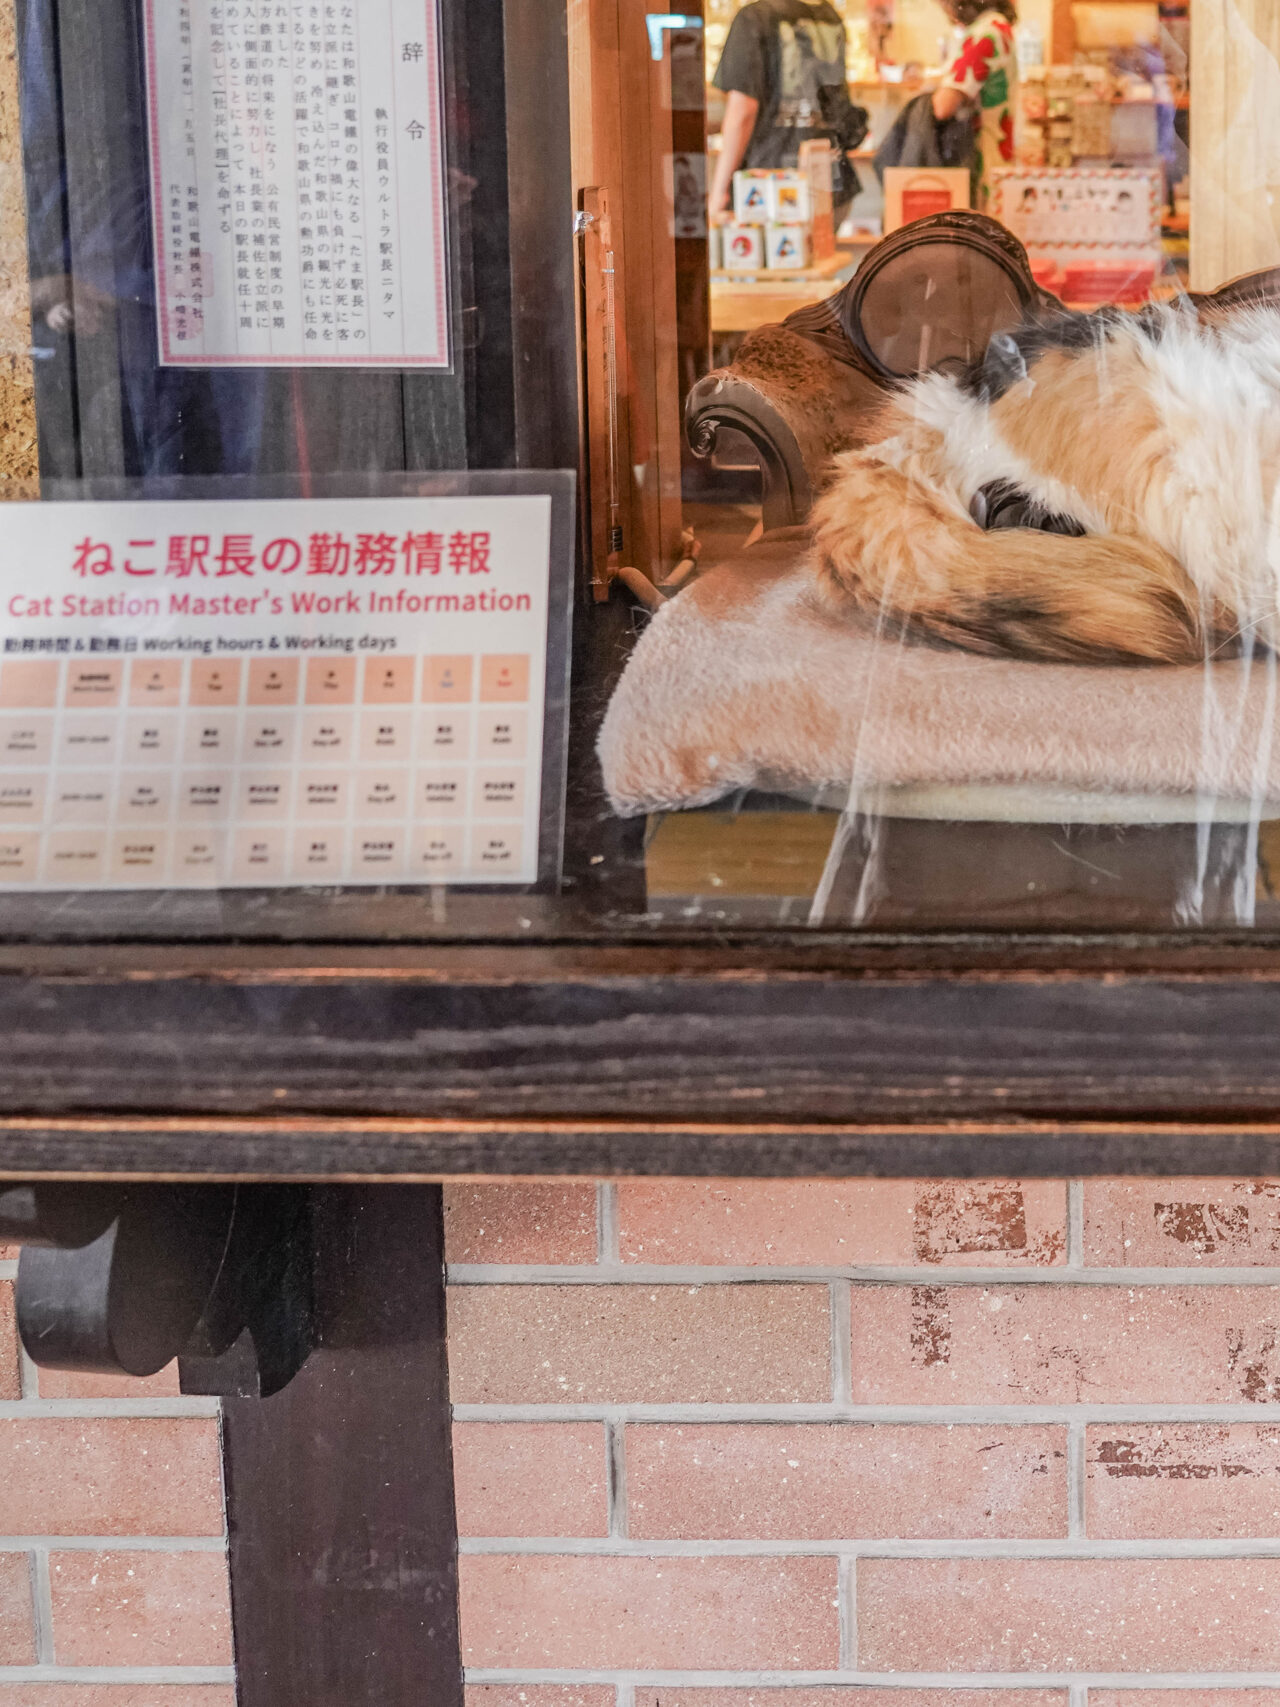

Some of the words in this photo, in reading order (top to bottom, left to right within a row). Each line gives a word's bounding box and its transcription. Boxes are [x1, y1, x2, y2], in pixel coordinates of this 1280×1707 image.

[72, 530, 491, 579] ねこ駅長の勤務情報
[8, 594, 53, 617] Cat
[61, 593, 160, 617] Station
[169, 589, 284, 616] Master's
[290, 590, 361, 615] Work
[368, 587, 532, 613] Information
[143, 637, 212, 654] Working
[217, 637, 264, 650] hours
[268, 636, 280, 651] &
[285, 635, 354, 652] Working
[358, 634, 397, 651] days
